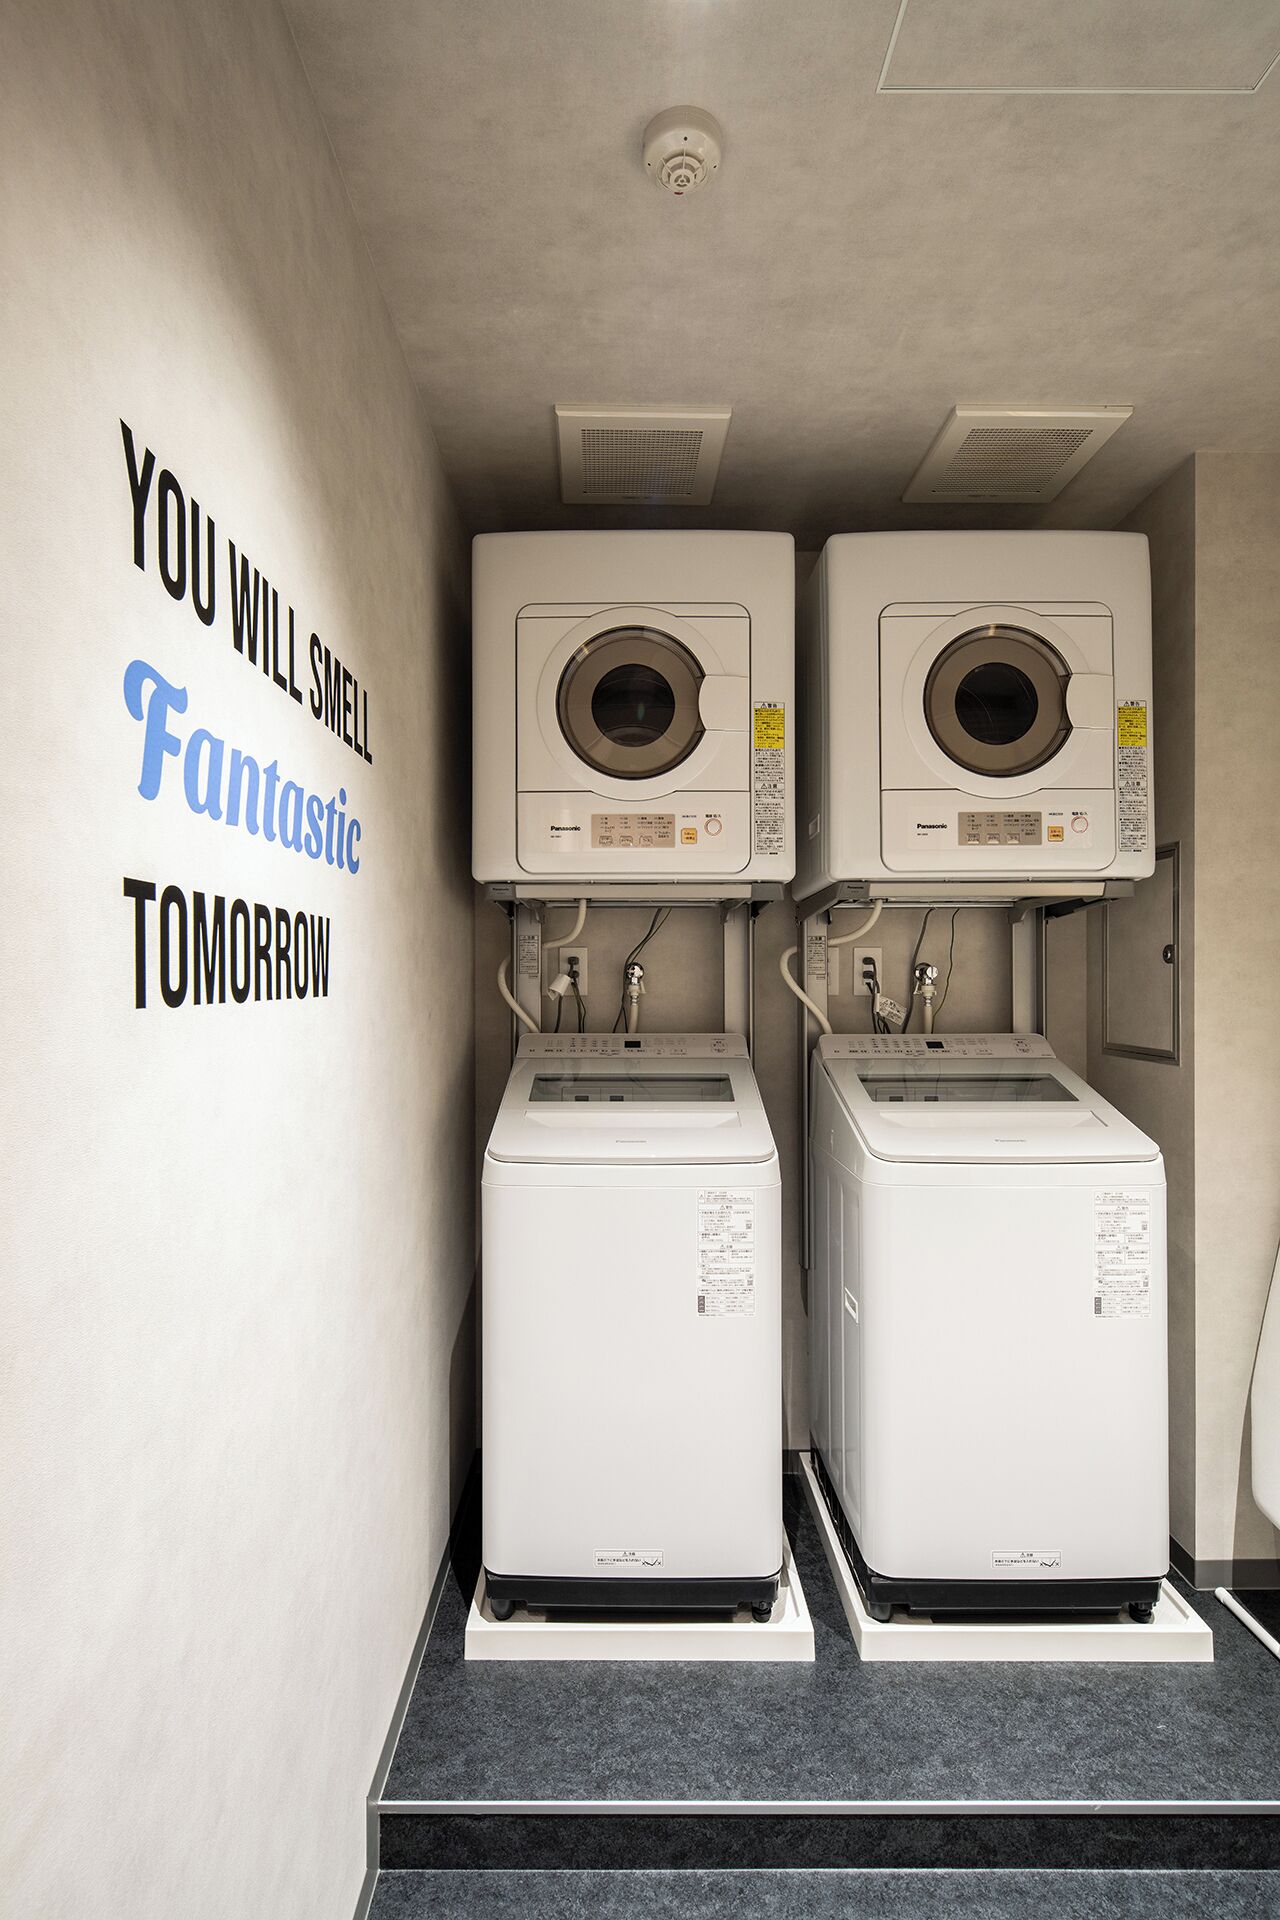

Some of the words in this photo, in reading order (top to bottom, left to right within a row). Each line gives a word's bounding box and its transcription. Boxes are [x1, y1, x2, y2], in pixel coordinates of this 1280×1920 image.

[119, 417, 215, 627] YOU
[228, 538, 303, 705] WILL
[309, 632, 373, 765] SMELL
[123, 660, 362, 875] Fantastic
[123, 877, 331, 1009] TOMORROW
